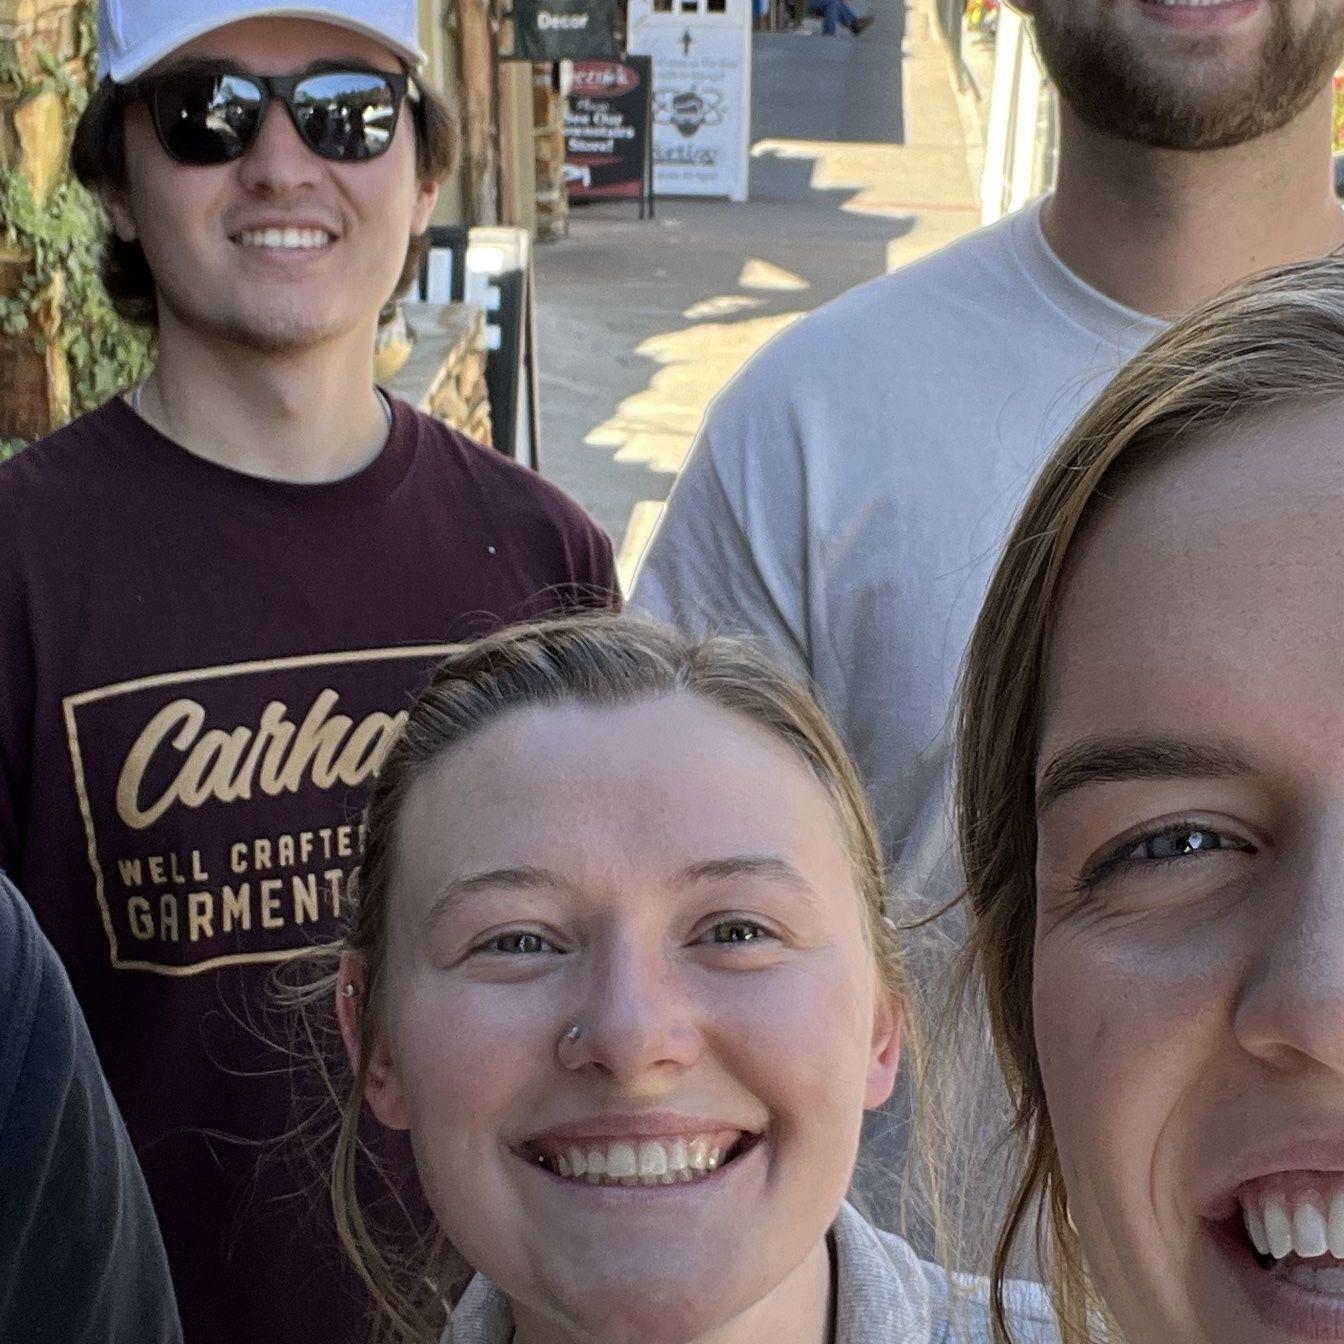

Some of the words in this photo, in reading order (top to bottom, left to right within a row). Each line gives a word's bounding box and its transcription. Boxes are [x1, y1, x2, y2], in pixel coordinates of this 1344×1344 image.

[536, 10, 590, 31] Decor
[115, 687, 409, 830] Carha
[117, 849, 209, 888] WELL
